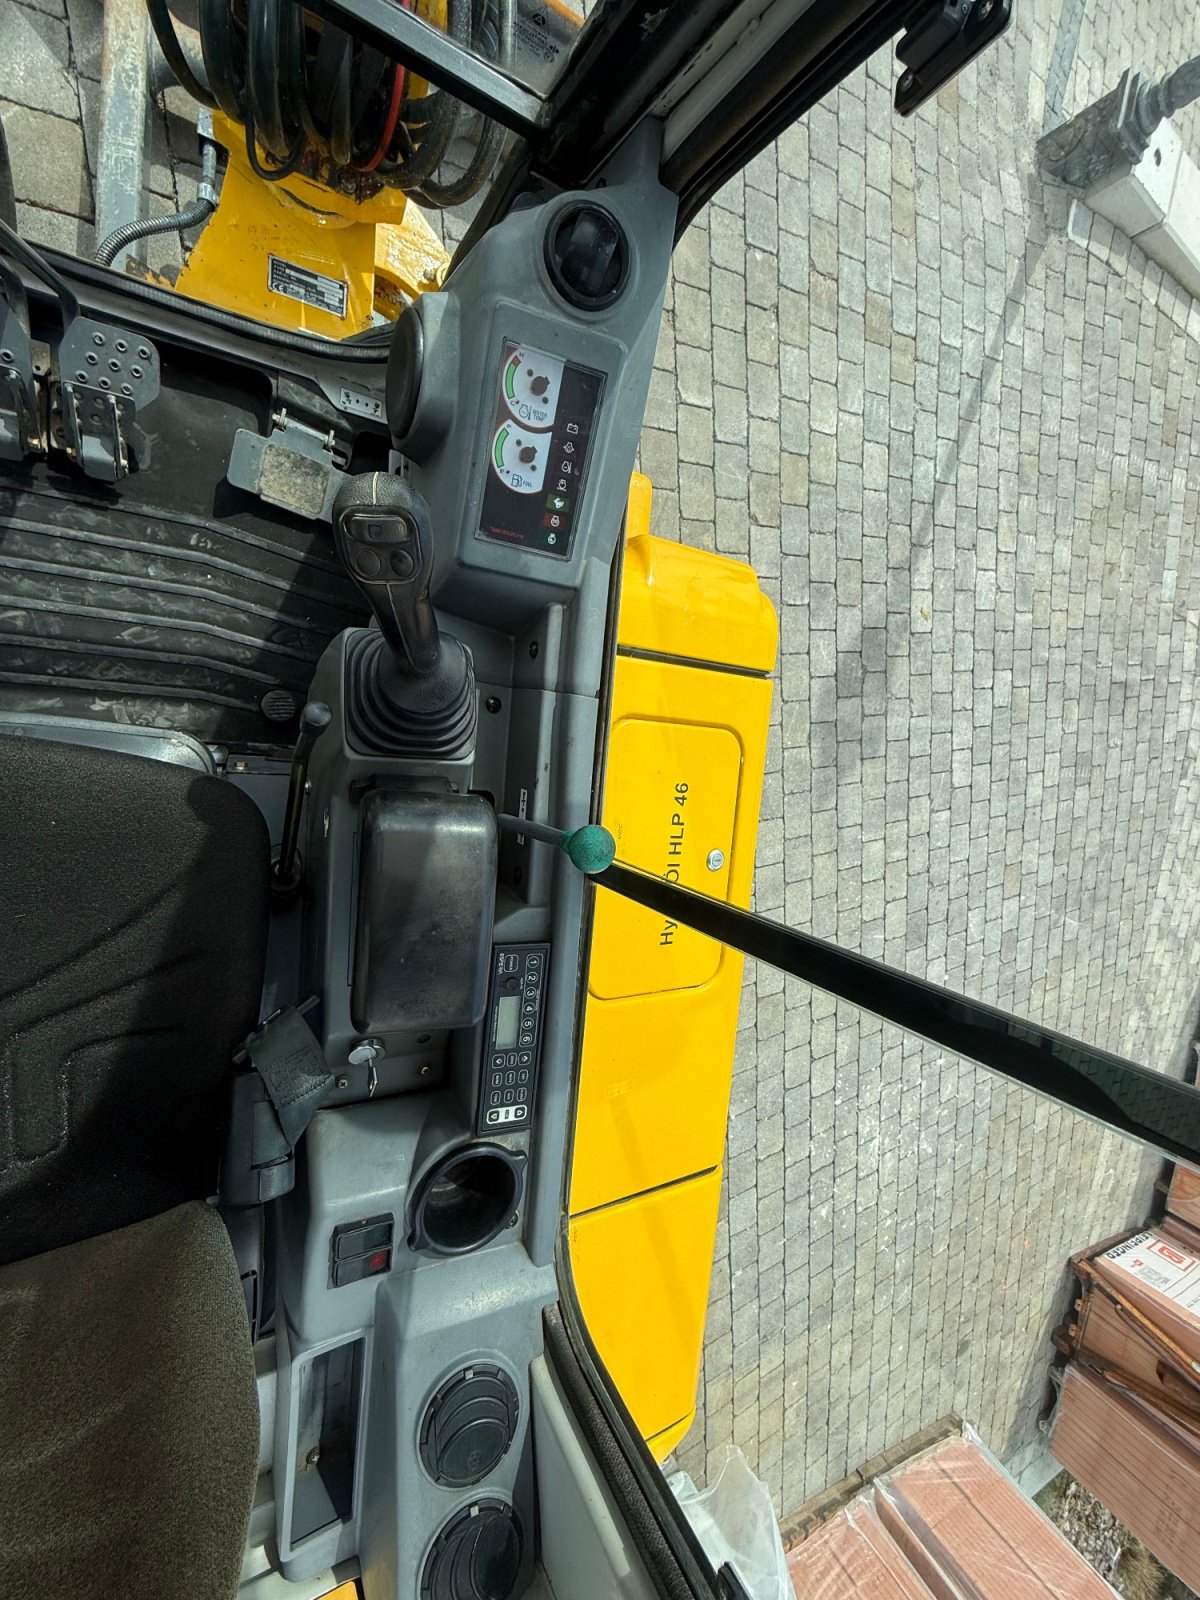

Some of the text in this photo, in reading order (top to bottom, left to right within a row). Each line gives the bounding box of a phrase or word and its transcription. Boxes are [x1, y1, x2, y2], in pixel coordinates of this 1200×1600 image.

[533, 409, 548, 417] WATER
[523, 480, 532, 488] FUEL
[674, 782, 689, 807] 46
[668, 813, 685, 855] HLP
